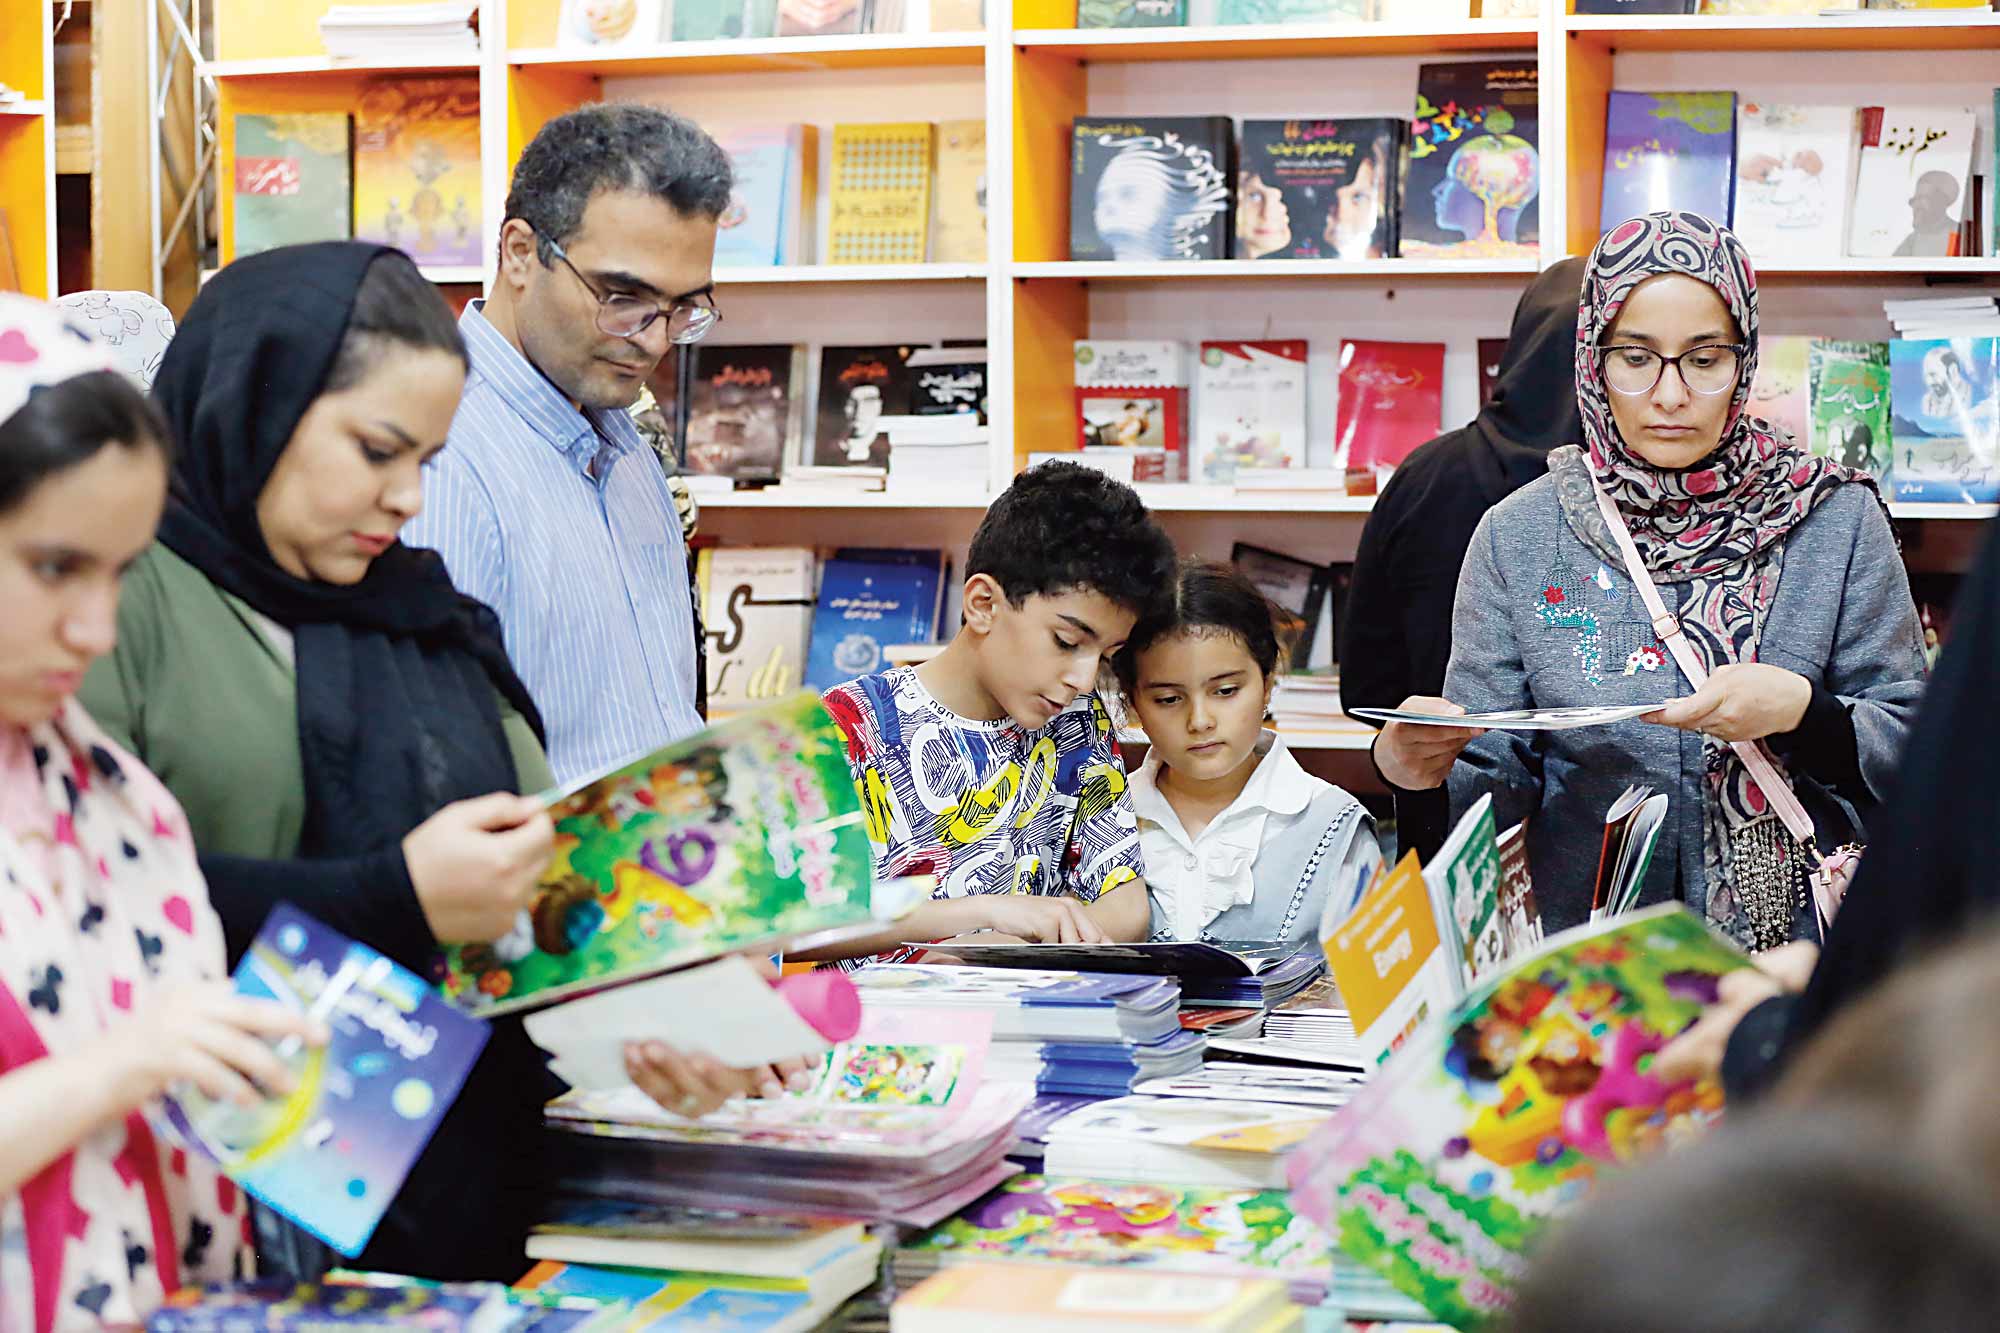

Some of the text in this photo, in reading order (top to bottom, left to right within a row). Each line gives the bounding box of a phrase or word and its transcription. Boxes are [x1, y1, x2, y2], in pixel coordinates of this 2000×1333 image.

[1885, 127, 1947, 176] معلم نمونه
[929, 699, 955, 720] ngn
